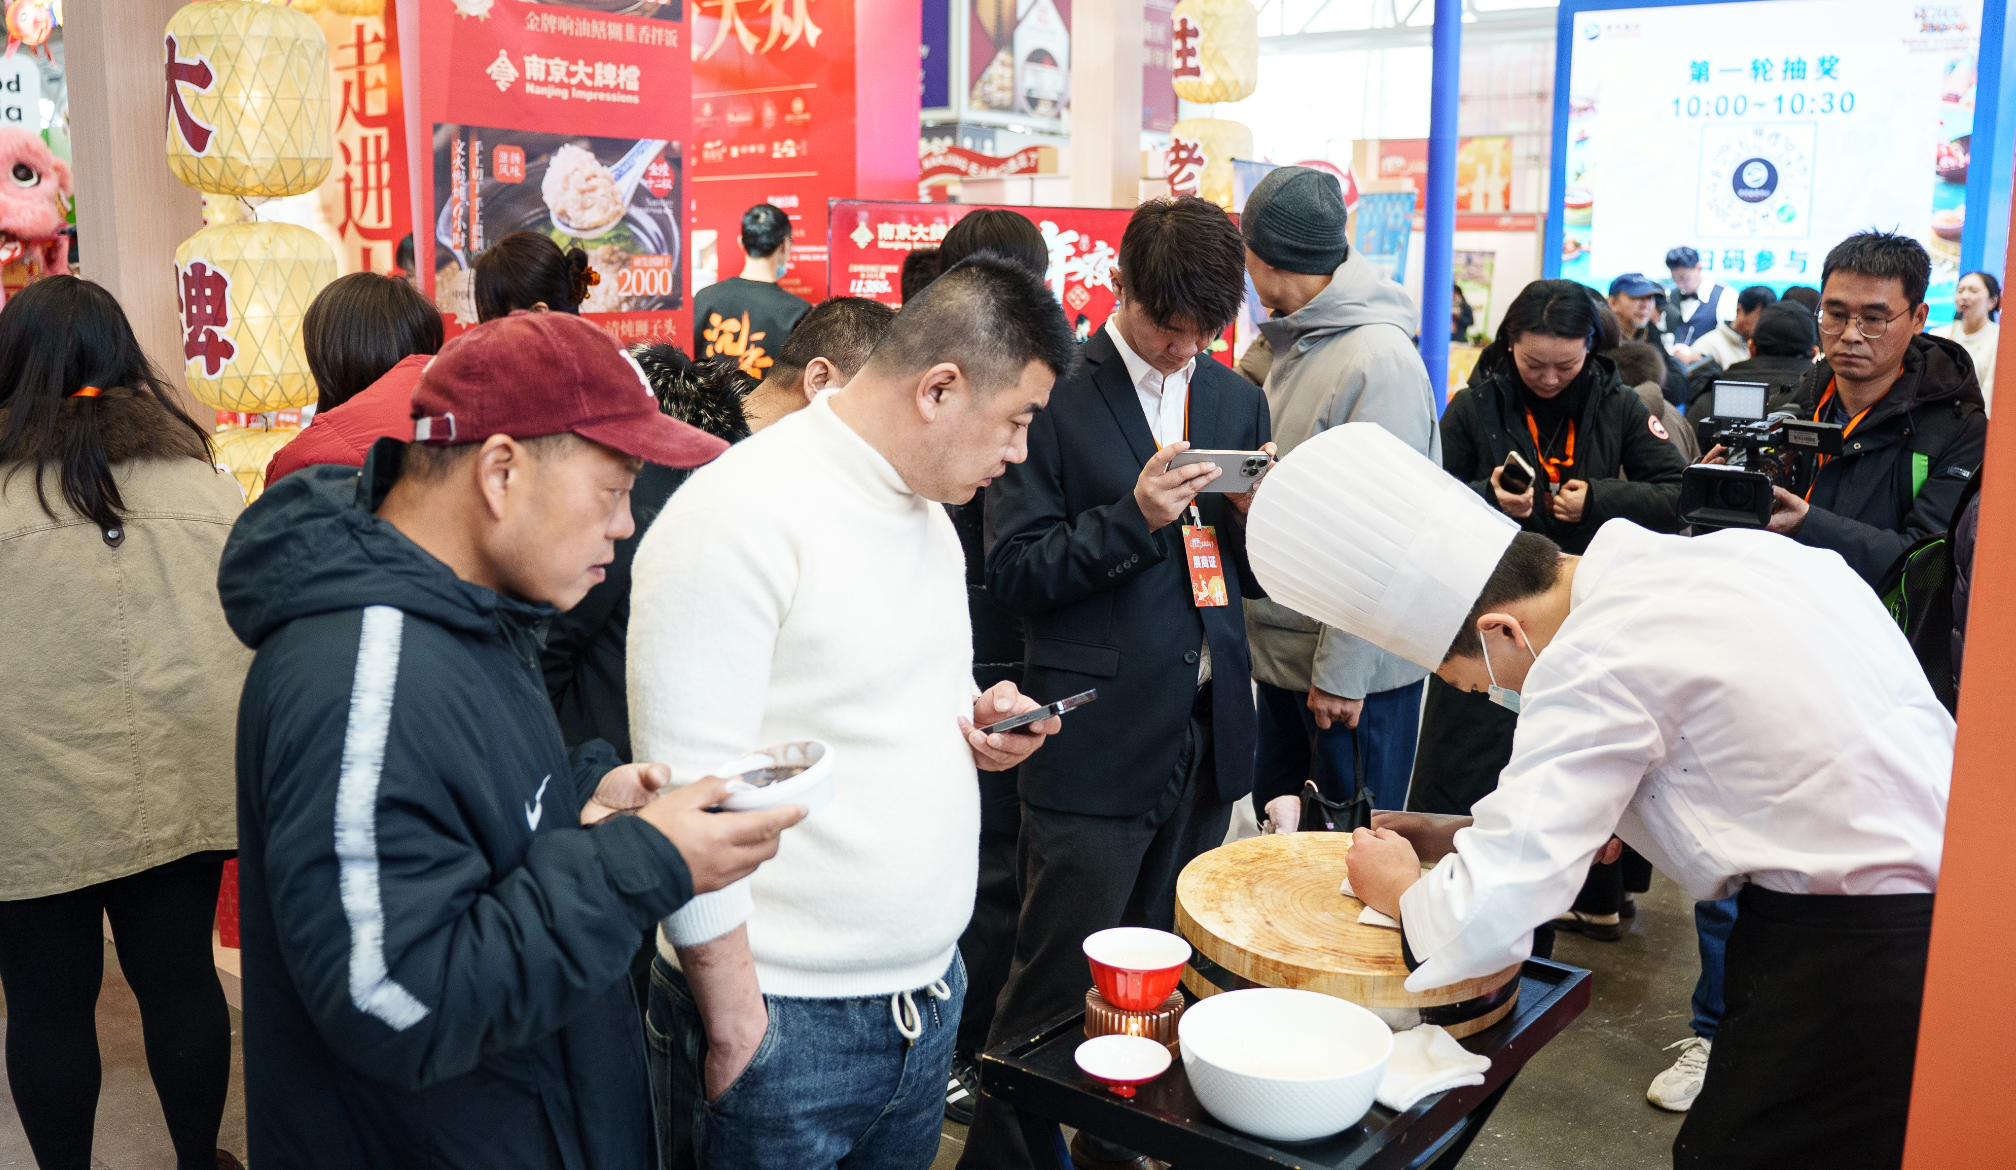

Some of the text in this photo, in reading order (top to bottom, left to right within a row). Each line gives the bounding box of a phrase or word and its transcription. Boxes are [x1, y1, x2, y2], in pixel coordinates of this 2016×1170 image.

[692, 0, 824, 62] 大众
[523, 54, 640, 91] 南京大牌檔
[1689, 55, 1841, 83] 第一轮抽奖
[525, 82, 640, 105] Nanjing Impressions
[0, 106, 22, 121] a
[877, 222, 955, 242] 南京大牌
[618, 268, 673, 296] 2000
[1193, 555, 1217, 569] 展商证
